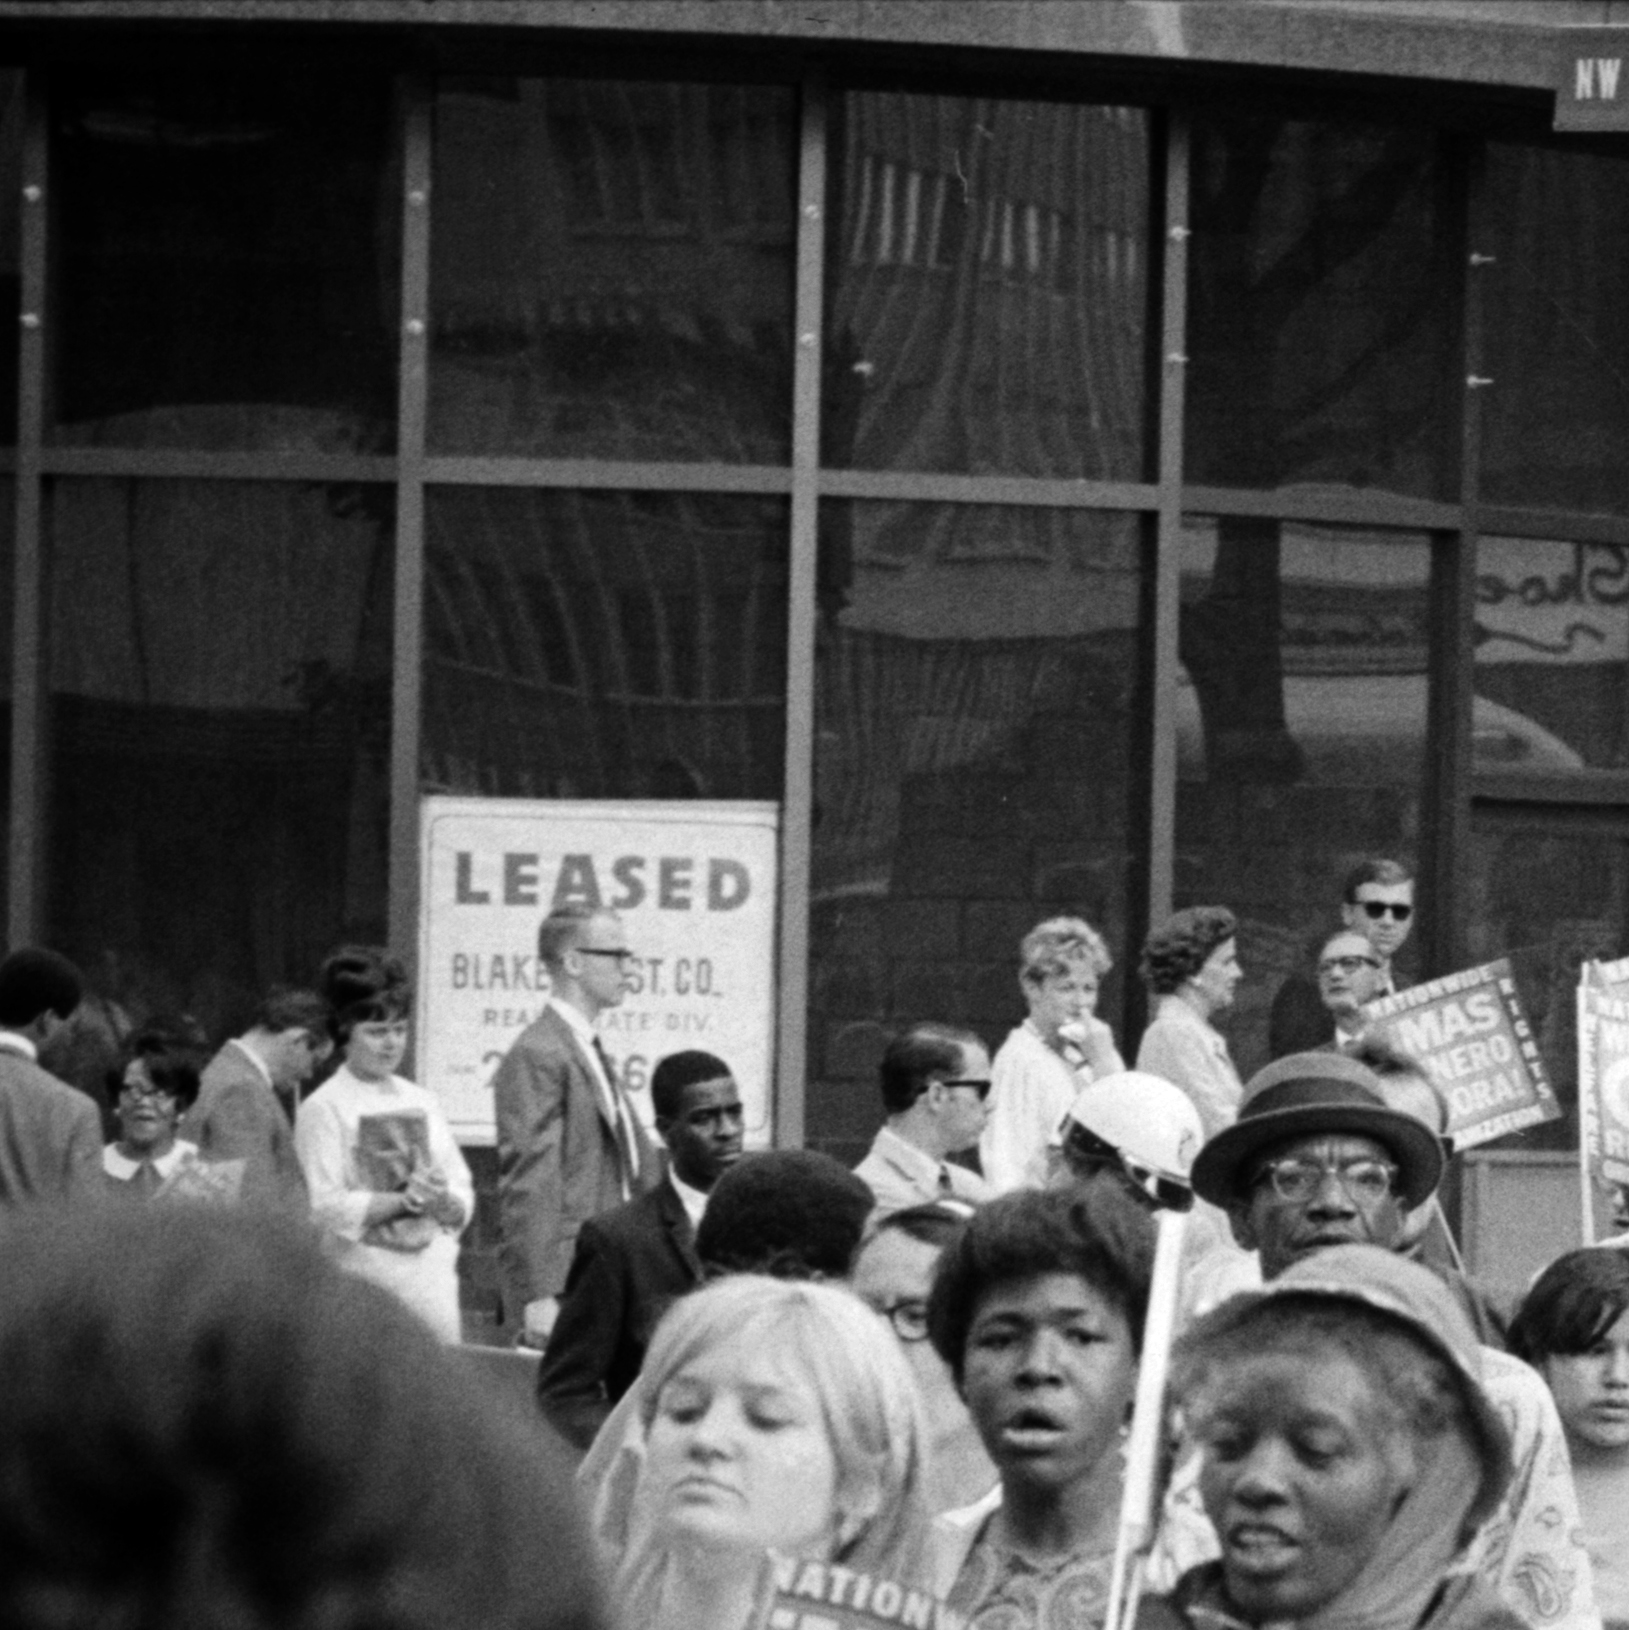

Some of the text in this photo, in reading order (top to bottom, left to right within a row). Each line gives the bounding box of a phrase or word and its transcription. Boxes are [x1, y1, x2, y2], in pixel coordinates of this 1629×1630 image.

[1575, 58, 1622, 100] NW
[454, 850, 752, 912] LEASED
[675, 957, 724, 998] CO.
[482, 1008, 533, 1027] REA
[604, 1011, 652, 1031] ATE
[1399, 993, 1502, 1053] MAS
[1499, 977, 1552, 1100] RIGHTS
[1427, 1033, 1514, 1081] NERO
[1450, 1068, 1528, 1117] ORA!
